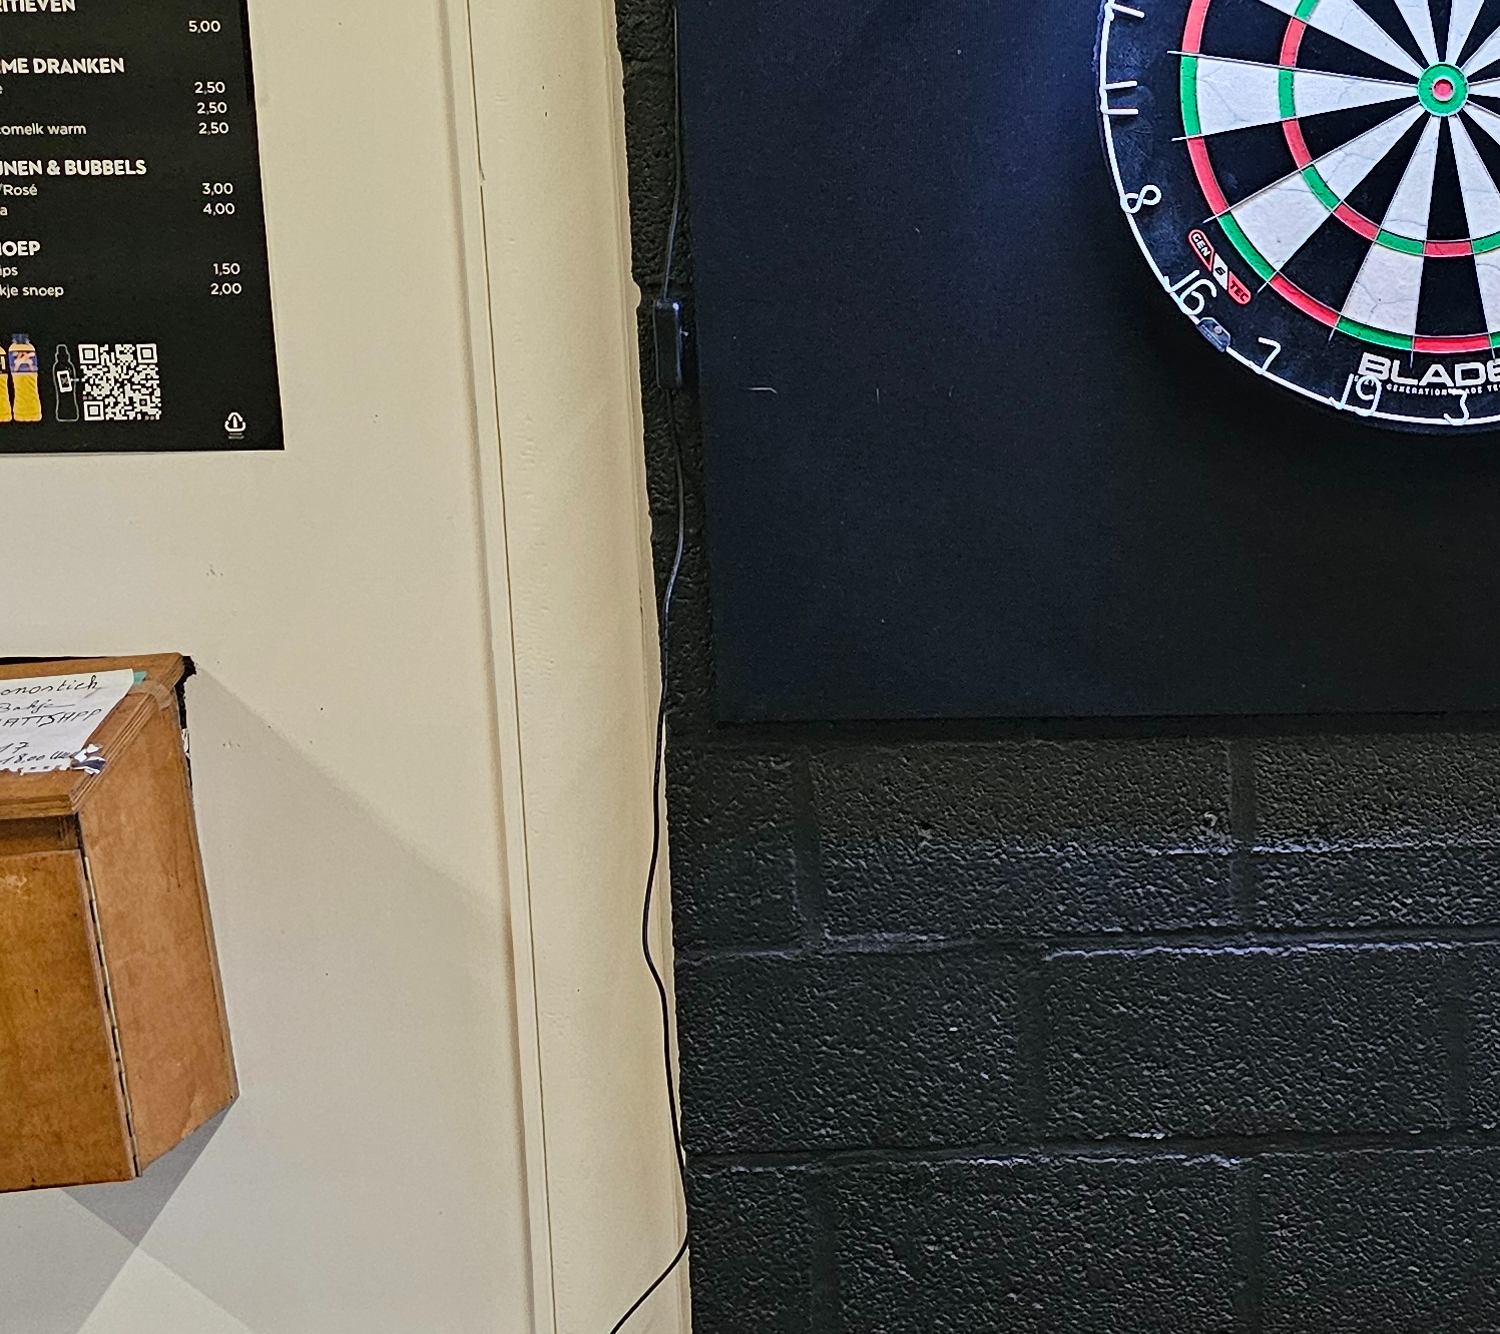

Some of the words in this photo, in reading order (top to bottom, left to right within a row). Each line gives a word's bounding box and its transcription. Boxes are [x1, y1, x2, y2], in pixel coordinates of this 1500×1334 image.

[189, 20, 221, 33] 5,00
[0, 58, 29, 74] ME
[33, 57, 125, 74] DRANKEN
[194, 82, 225, 95] 2,50
[197, 102, 227, 115] 2,50
[47, 124, 87, 135] warm
[199, 122, 229, 135] 2,50
[47, 159, 60, 176] &
[64, 159, 147, 176] BUBBELS
[202, 182, 233, 196] 3,00
[1120, 185, 1161, 214] 8
[203, 202, 235, 216] 4,00
[213, 263, 240, 276] 1,50
[1191, 233, 1211, 257] GEN
[1230, 280, 1249, 302] TEC
[22, 286, 64, 298] snoep
[210, 283, 242, 296] 2,00
[1163, 269, 1217, 315] 16
[1253, 336, 1281, 375] 7
[1329, 373, 1382, 417] 19
[1443, 388, 1469, 426] 3
